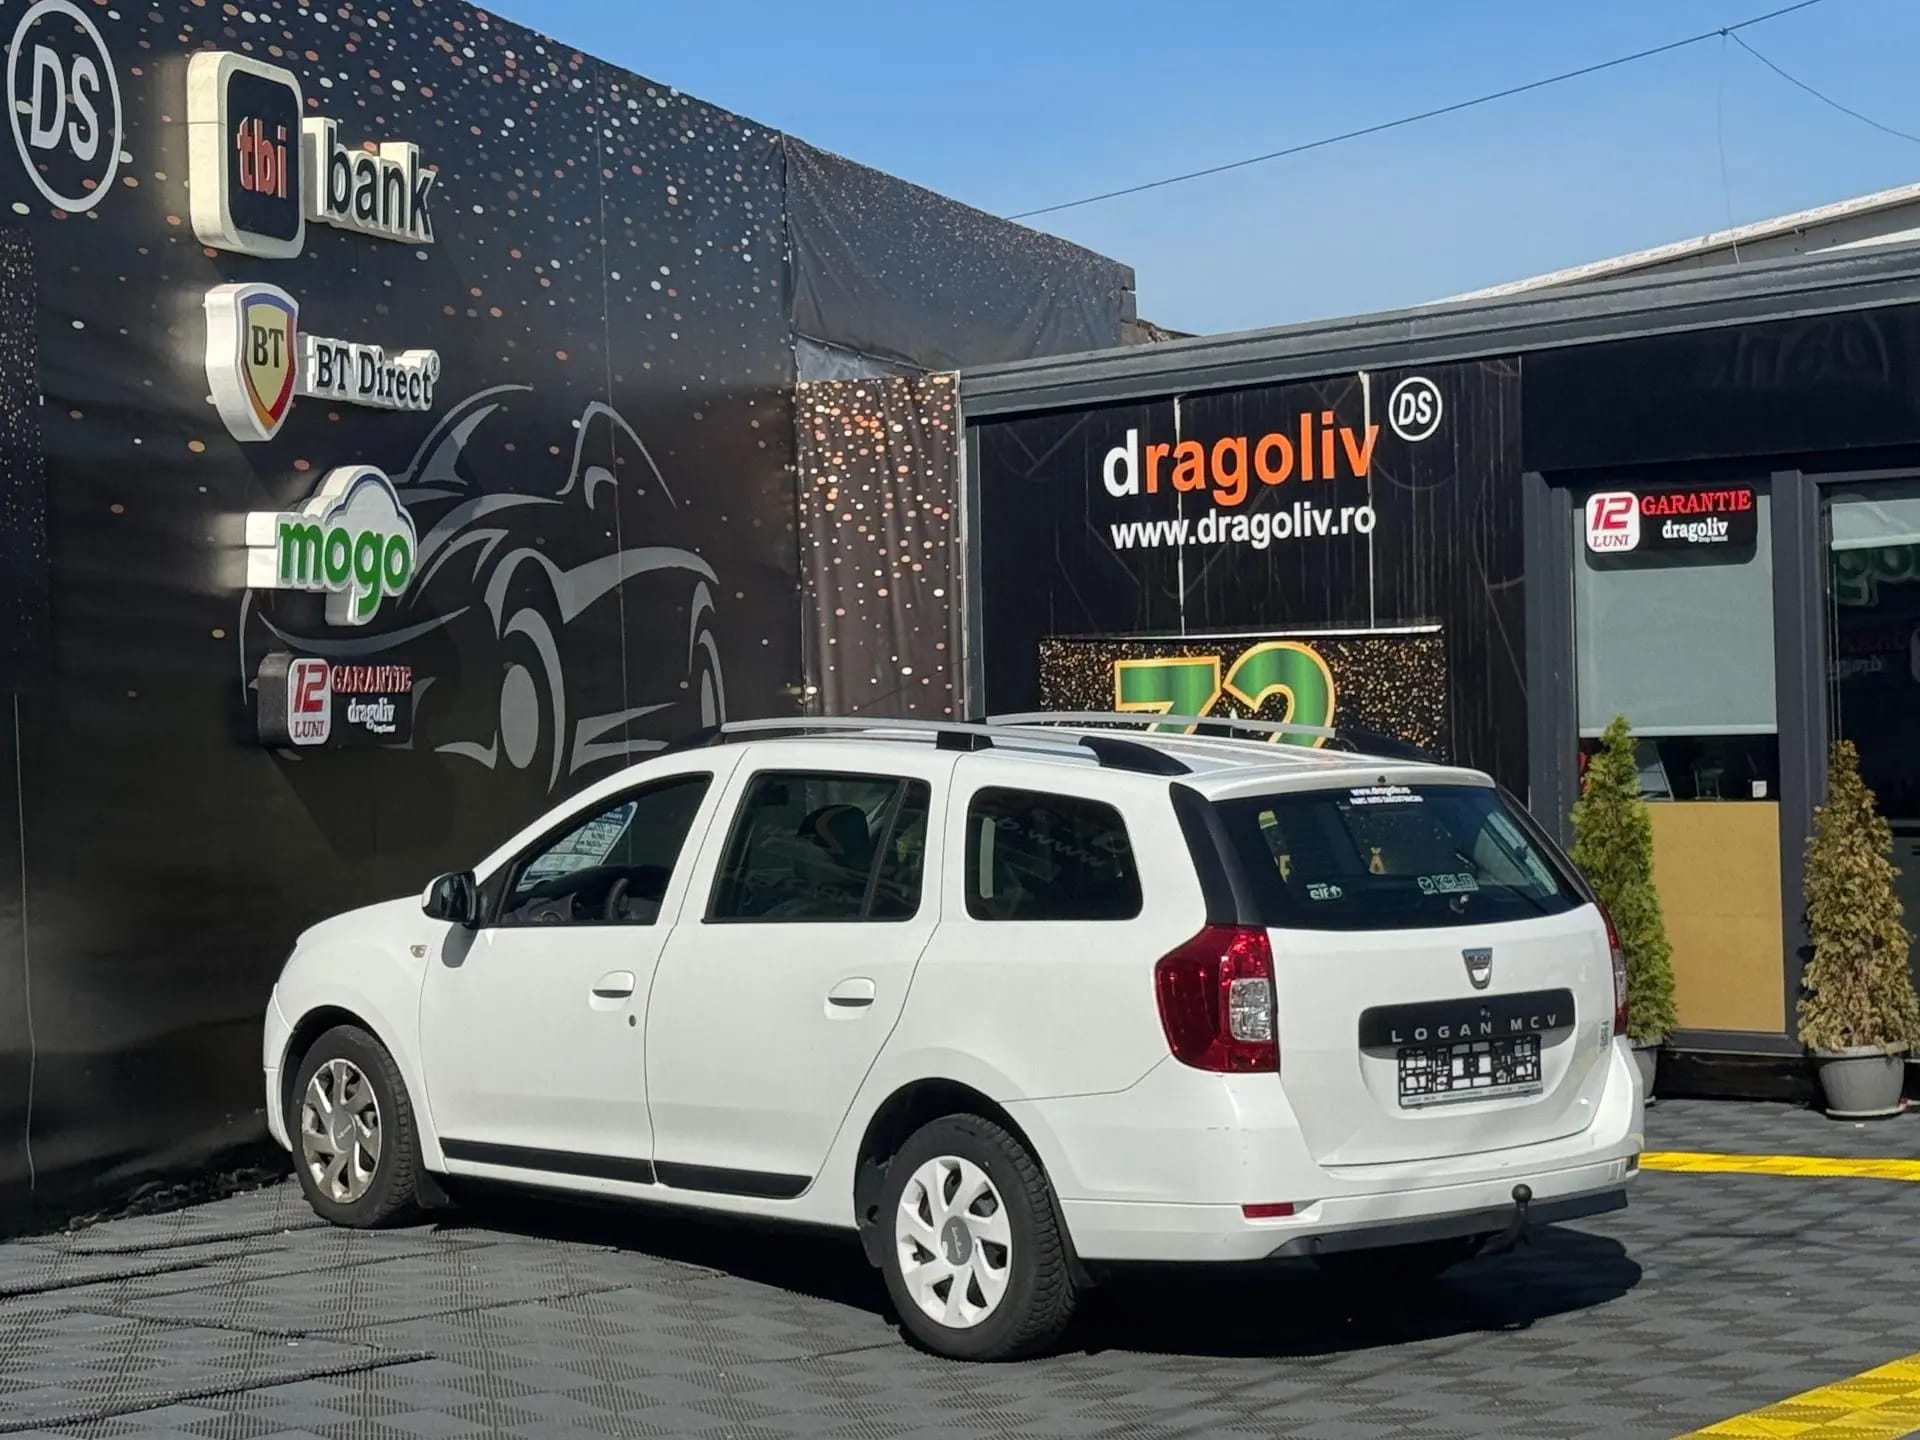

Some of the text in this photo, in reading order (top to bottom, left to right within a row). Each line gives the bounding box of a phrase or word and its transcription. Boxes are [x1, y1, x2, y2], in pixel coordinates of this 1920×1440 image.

[30, 43, 100, 161] DS
[237, 116, 431, 236] tbi bank
[252, 325, 284, 369] BT
[316, 343, 351, 391] BT
[1397, 391, 1432, 426] DS
[1103, 410, 1379, 507] dragoliv
[1111, 500, 1377, 550] www.dragoliv.ro
[1591, 489, 1752, 531] 12 GARANTIE
[1662, 516, 1729, 542] dragoliv
[1593, 534, 1629, 548] LUNI
[279, 522, 410, 617] mogo
[293, 664, 412, 714] 12 GARANTIE
[293, 719, 325, 738] LUNI
[347, 697, 396, 730] dragoliv
[1391, 1014, 1557, 1043] LOGAN MCV
